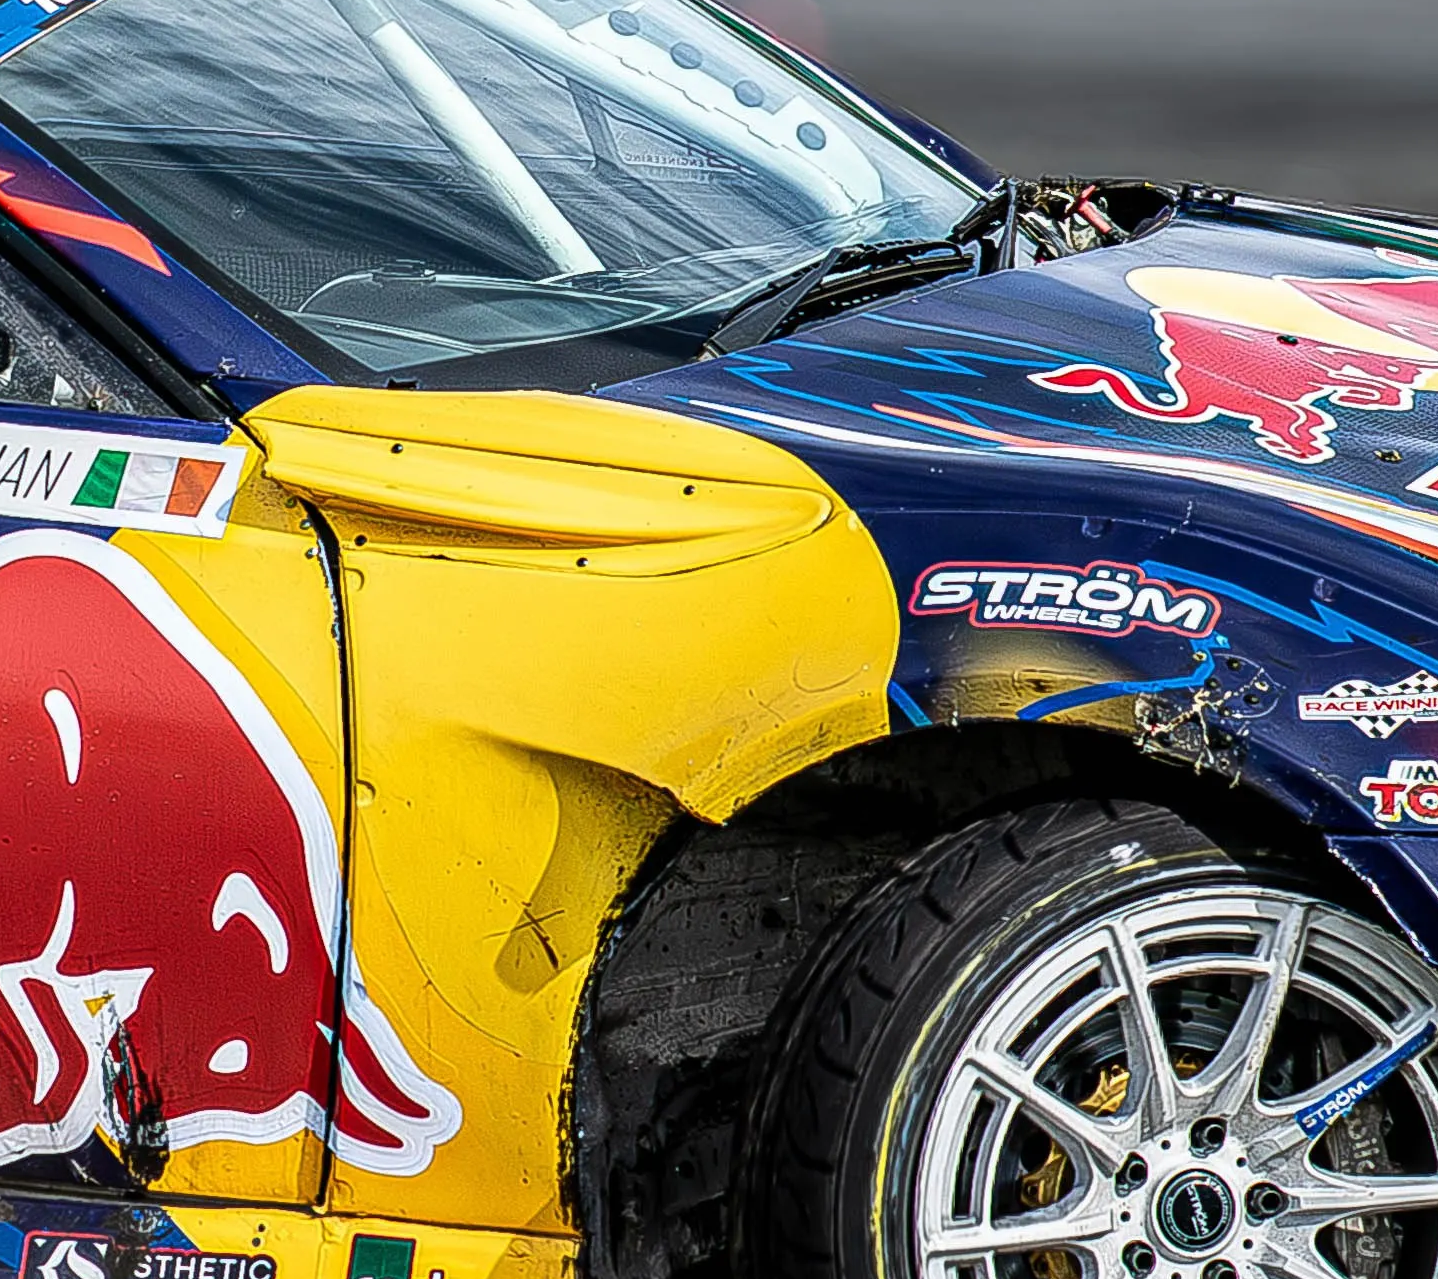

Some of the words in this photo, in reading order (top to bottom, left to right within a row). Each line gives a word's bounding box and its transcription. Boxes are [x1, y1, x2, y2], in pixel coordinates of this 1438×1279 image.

[922, 569, 1207, 630] STRÖM
[984, 604, 1122, 628] WHEELS
[1305, 701, 1368, 712] RACE
[1302, 1079, 1371, 1128] STRÖM
